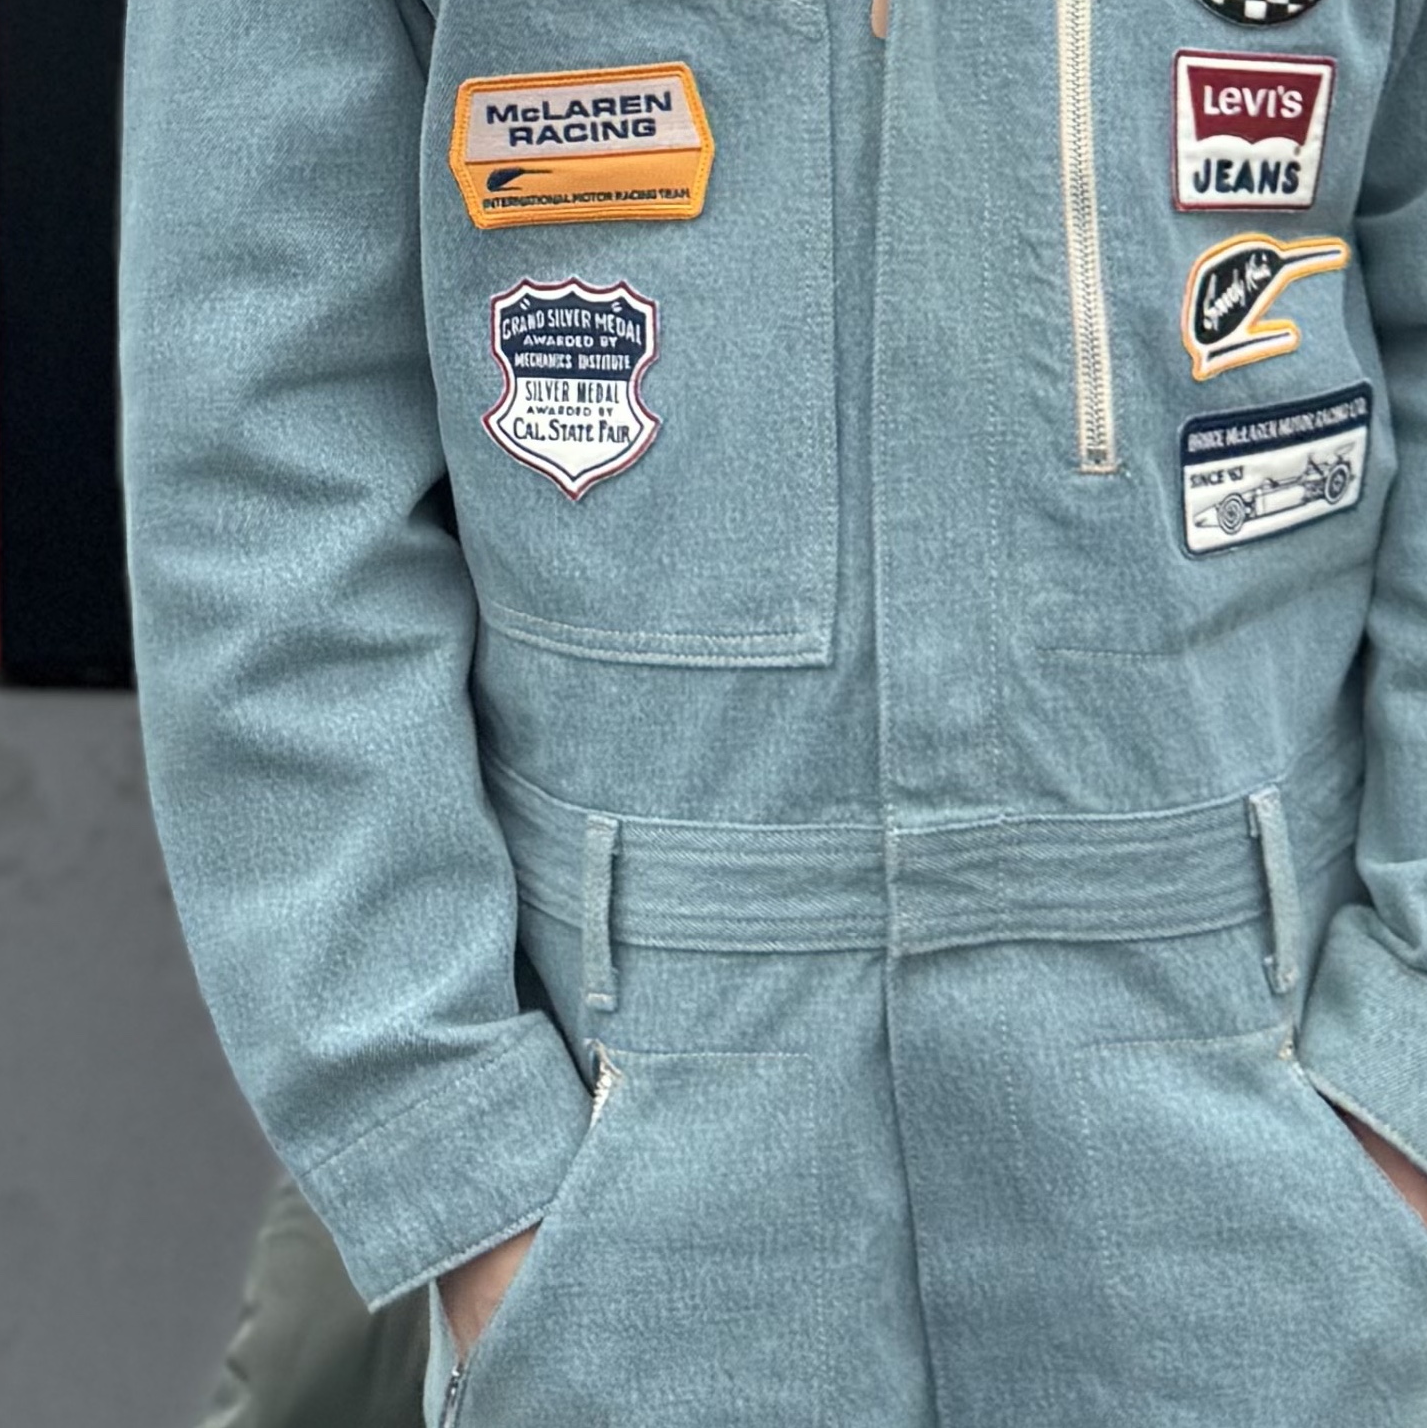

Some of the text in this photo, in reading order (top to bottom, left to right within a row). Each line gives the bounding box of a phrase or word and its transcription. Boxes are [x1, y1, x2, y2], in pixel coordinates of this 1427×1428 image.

[486, 91, 672, 124] McLAREN
[508, 118, 656, 146] RACING
[1193, 158, 1301, 194] JEANS
[483, 188, 690, 208] INTERNATIONAL MOTOR RACING TEAM
[502, 308, 642, 346] GRAND SILVER MEDAL
[523, 335, 618, 348] AWARDED BY
[578, 353, 631, 370] INSTITUTE
[525, 380, 619, 404] SILVER MEDAL
[526, 405, 614, 417] AWARDED BY
[1189, 470, 1225, 488] SINCE
